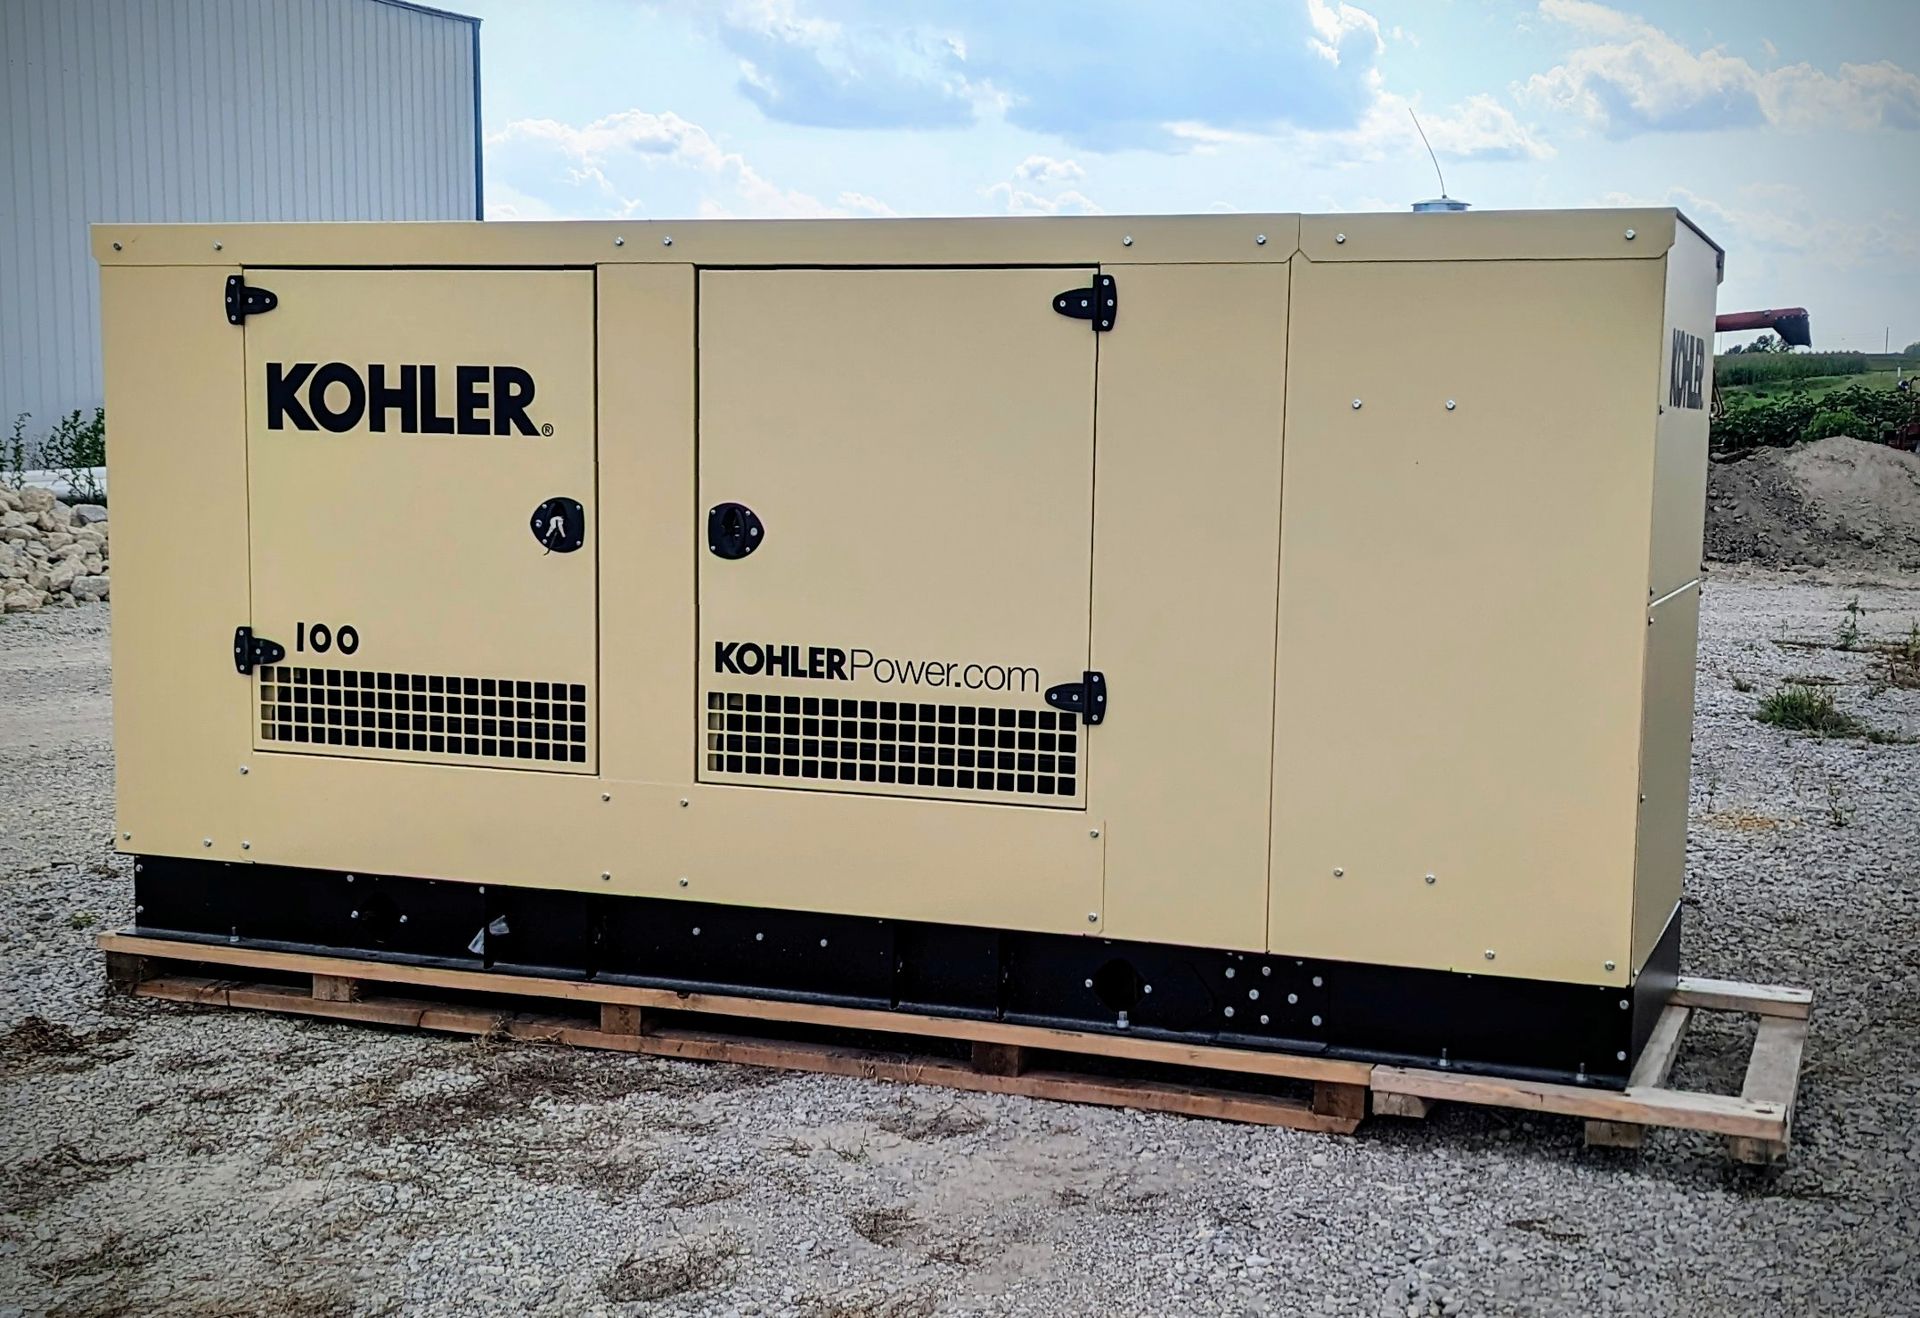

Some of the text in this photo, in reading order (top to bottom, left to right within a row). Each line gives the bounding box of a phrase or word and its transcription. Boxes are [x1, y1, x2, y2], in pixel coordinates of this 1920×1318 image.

[1669, 327, 1705, 410] KOHLER
[297, 622, 359, 655] 100
[715, 641, 1039, 692] KOHLERPower.com
